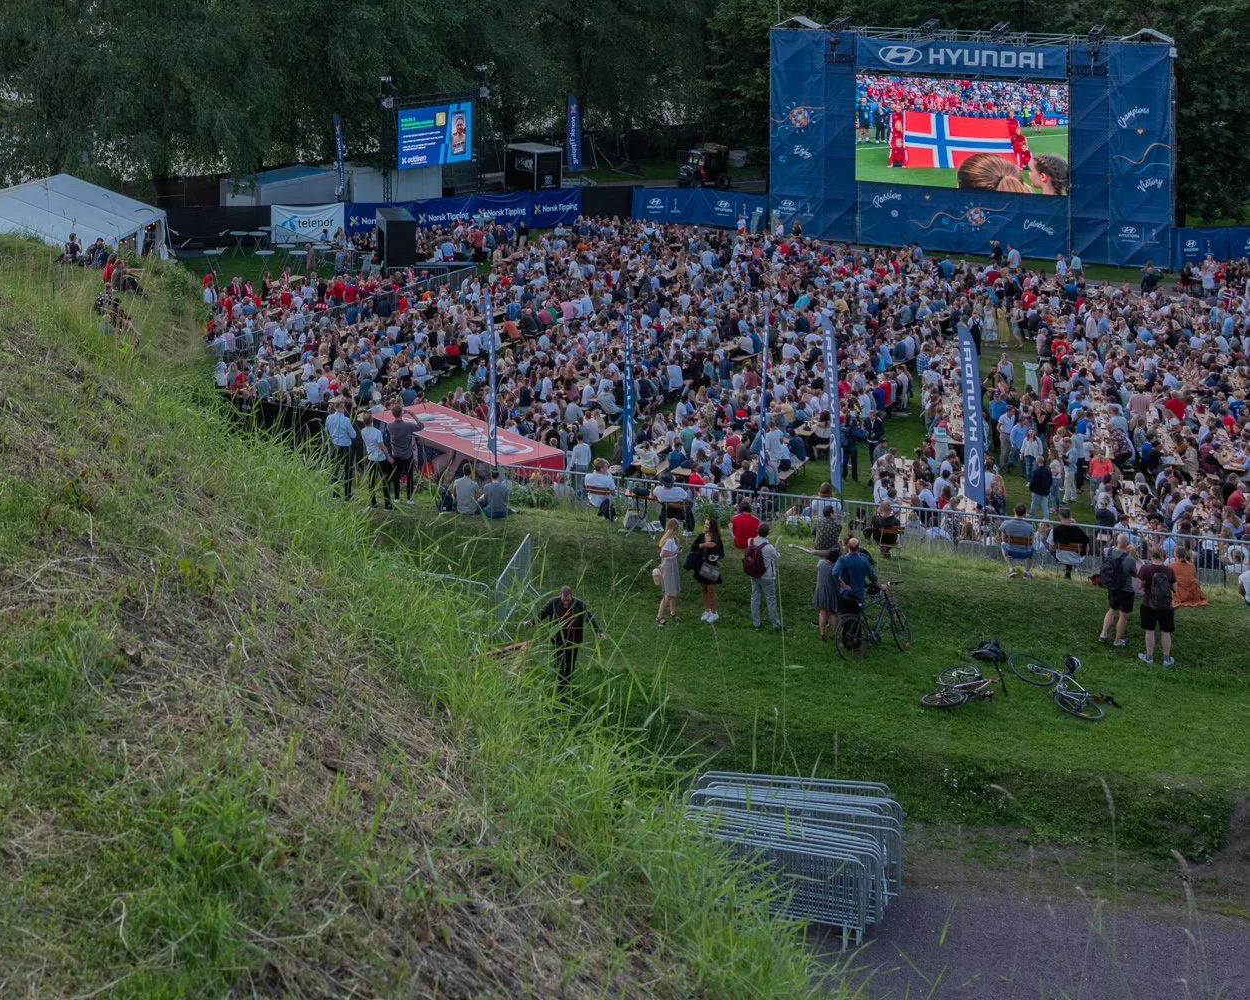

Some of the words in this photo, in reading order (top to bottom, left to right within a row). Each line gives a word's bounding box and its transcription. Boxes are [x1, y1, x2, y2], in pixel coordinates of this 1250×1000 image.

[928, 48, 1044, 70] HYUNDAI
[1117, 106, 1150, 129] Champions
[1136, 177, 1164, 193] Victory
[558, 202, 578, 212] Tipping
[872, 189, 902, 208] Passion
[428, 213, 447, 222] Norsk
[504, 207, 527, 217] Tipping
[298, 216, 334, 228] telenor
[825, 329, 836, 429] HYUNDAI
[963, 340, 978, 442] HYUNDAI
